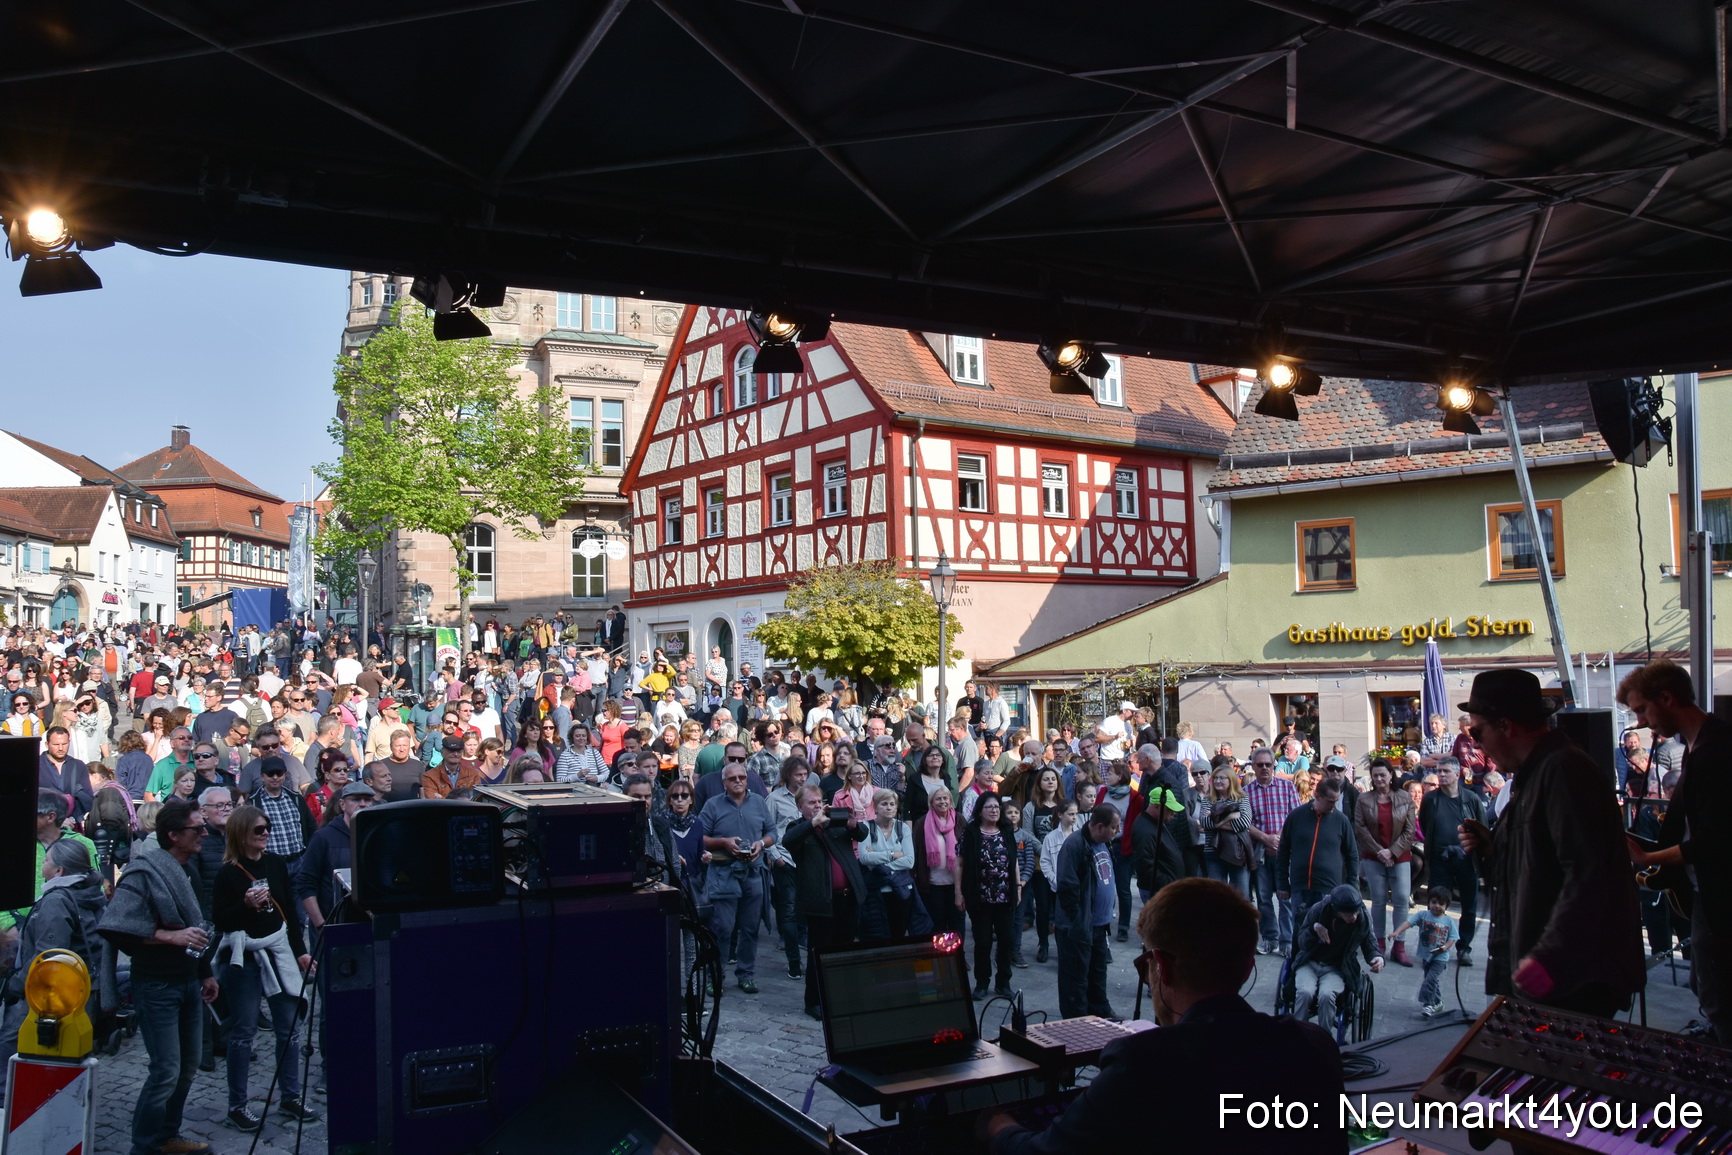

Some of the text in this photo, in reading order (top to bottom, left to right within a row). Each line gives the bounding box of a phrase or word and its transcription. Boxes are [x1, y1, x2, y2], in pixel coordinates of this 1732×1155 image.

[1287, 614, 1535, 646] Gasthaus gold. Stern
